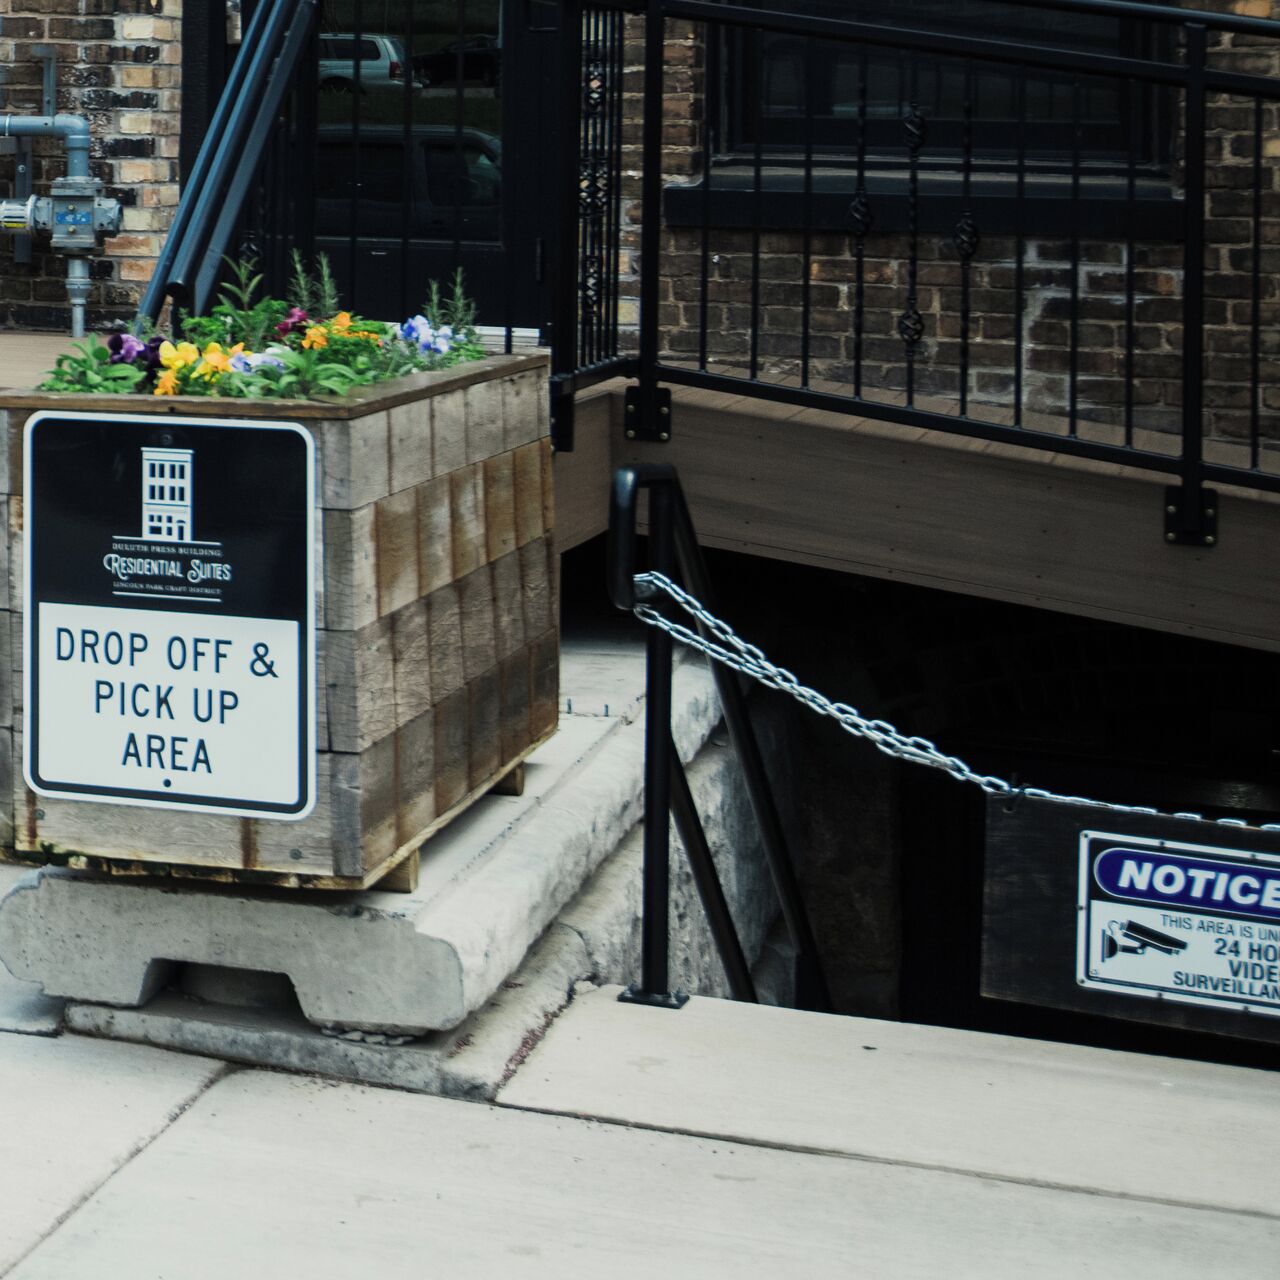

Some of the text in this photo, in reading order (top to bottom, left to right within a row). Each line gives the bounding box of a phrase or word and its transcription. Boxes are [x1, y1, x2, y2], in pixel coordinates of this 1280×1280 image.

[112, 543, 222, 557] DULUTH PRESS BUILDING
[56, 627, 279, 679] DROP OFF &
[95, 680, 239, 724] PICK UP
[122, 732, 213, 774] AREA
[1118, 860, 1280, 907] NOTICE
[1160, 913, 1280, 942] THIS AREA IS UN
[1215, 937, 1280, 962] 24 HO
[1228, 959, 1280, 983] VIDE
